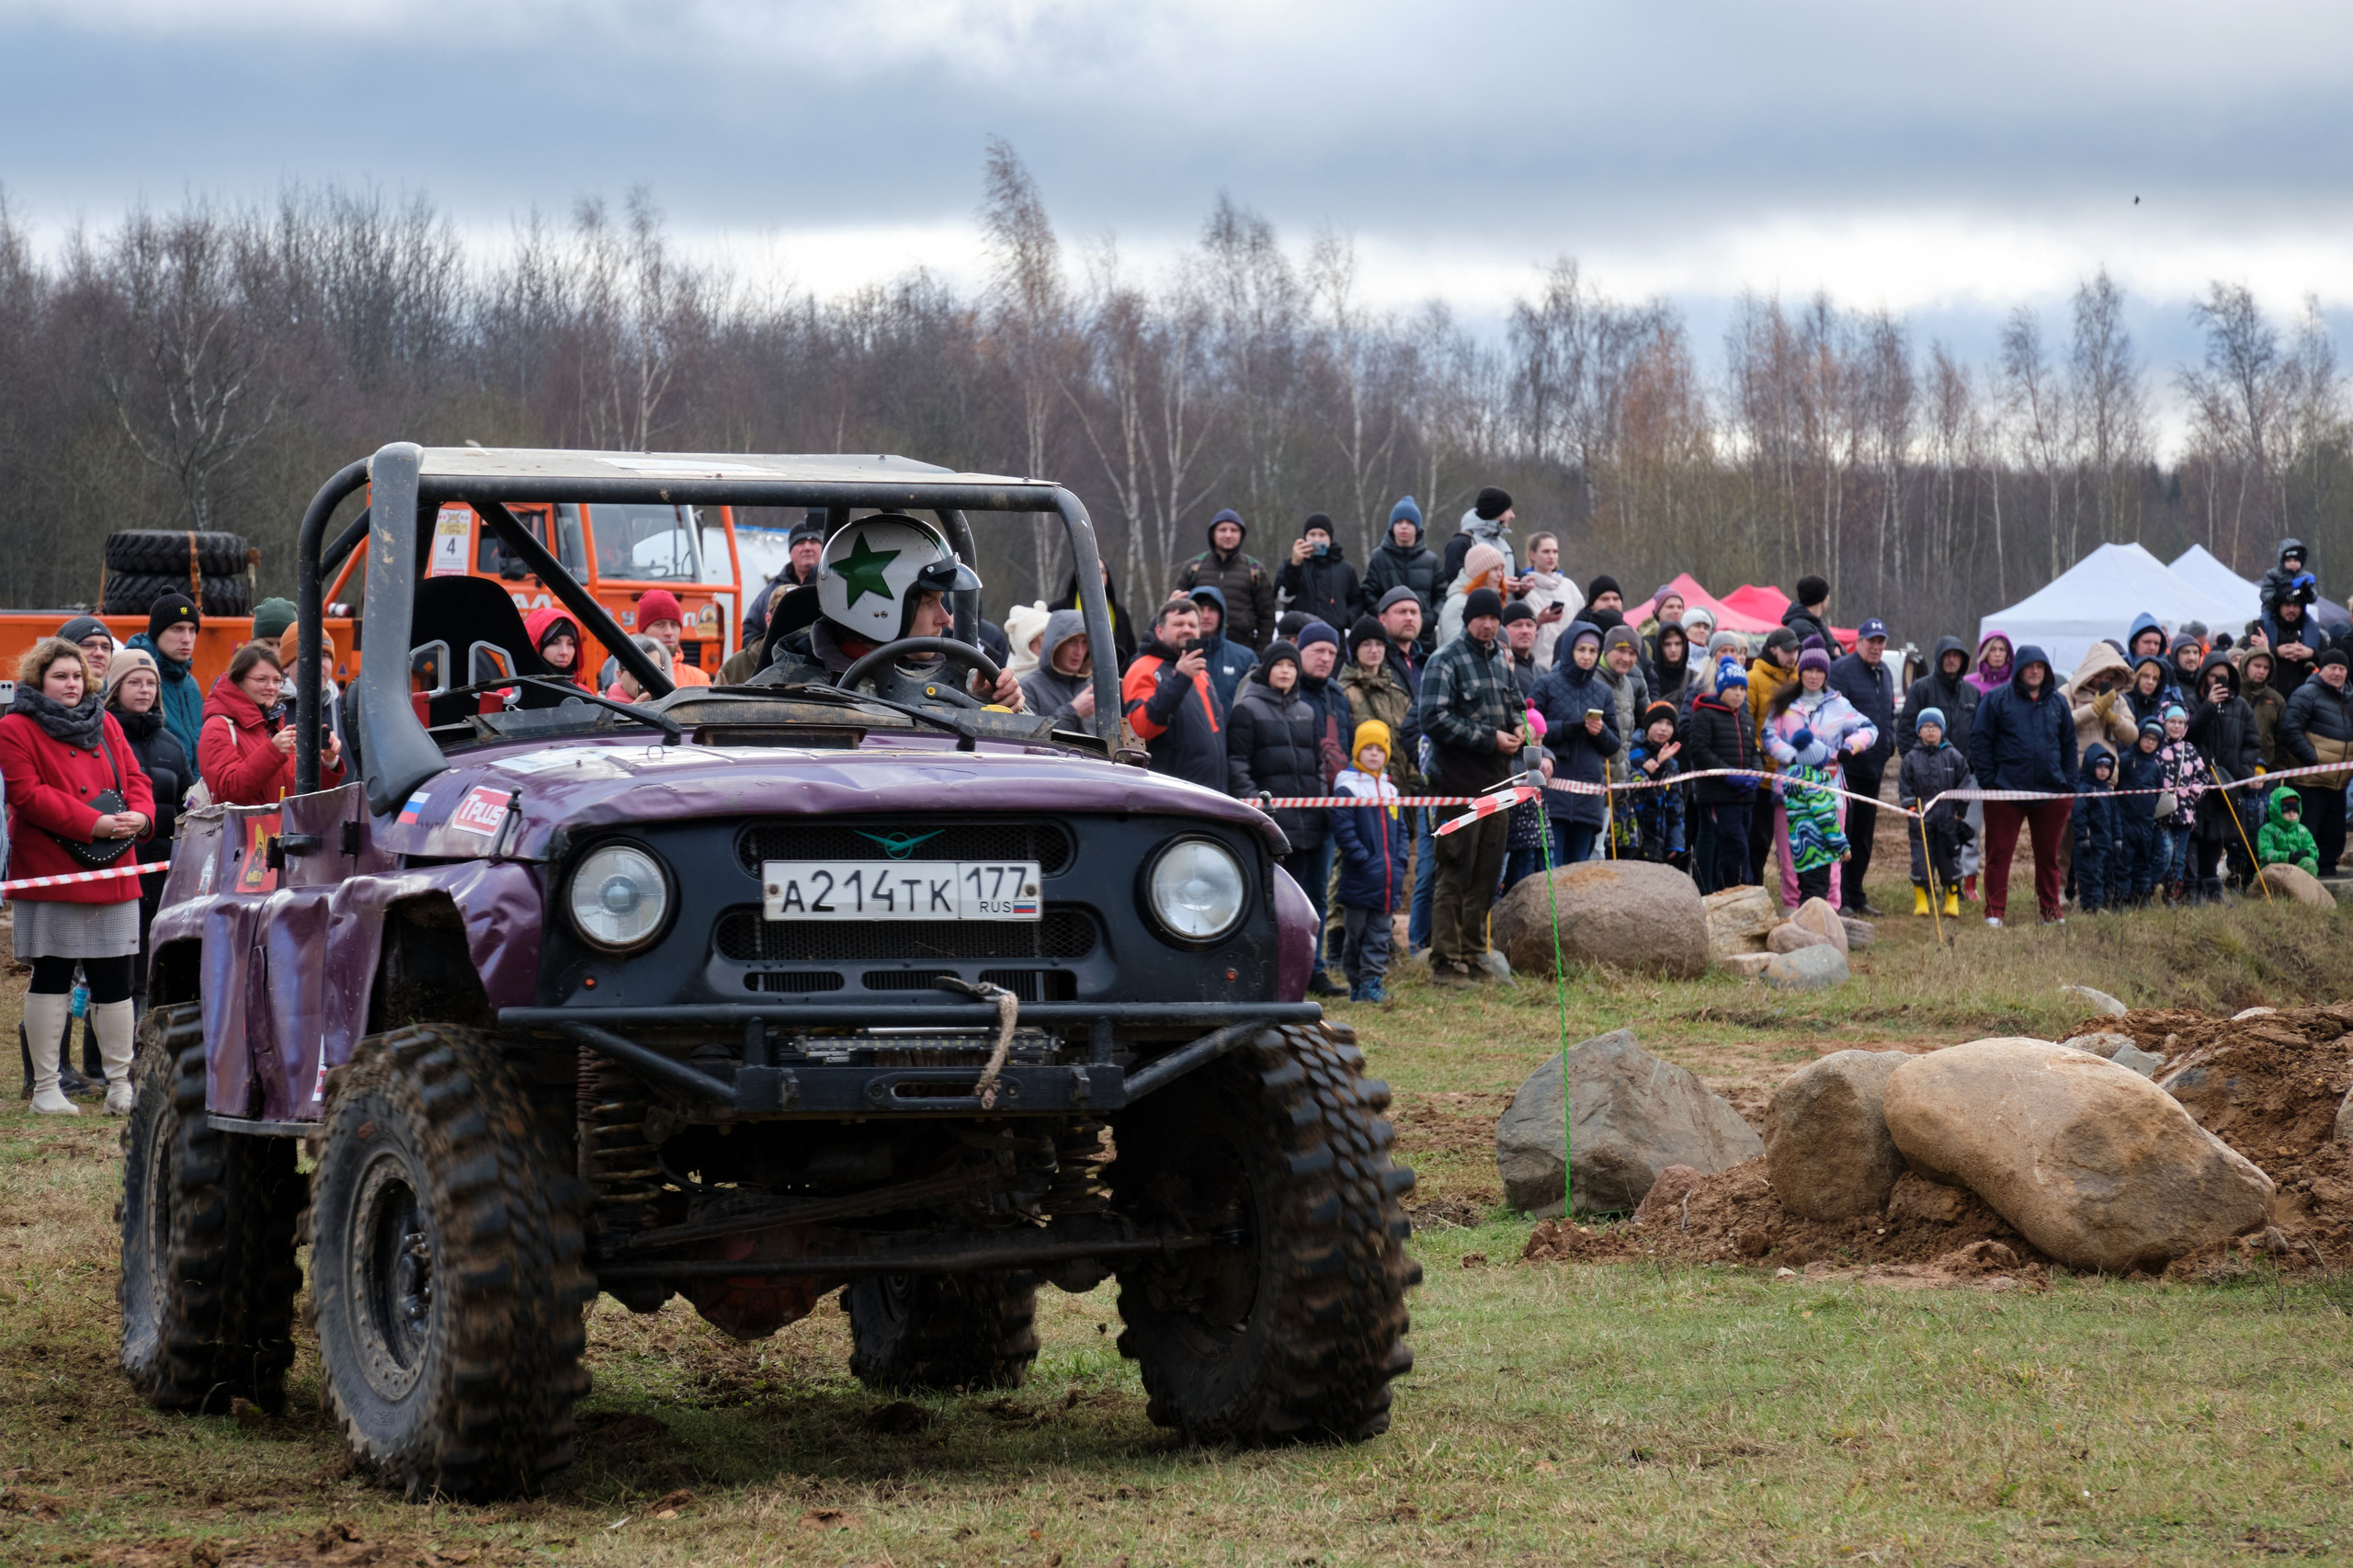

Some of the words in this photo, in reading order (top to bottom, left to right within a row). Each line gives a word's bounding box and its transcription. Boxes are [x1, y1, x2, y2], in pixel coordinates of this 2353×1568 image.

[446, 537, 456, 555] 4
[781, 869, 952, 913] А214ТК
[965, 867, 1028, 899] 177
[980, 901, 1011, 913] RUS
